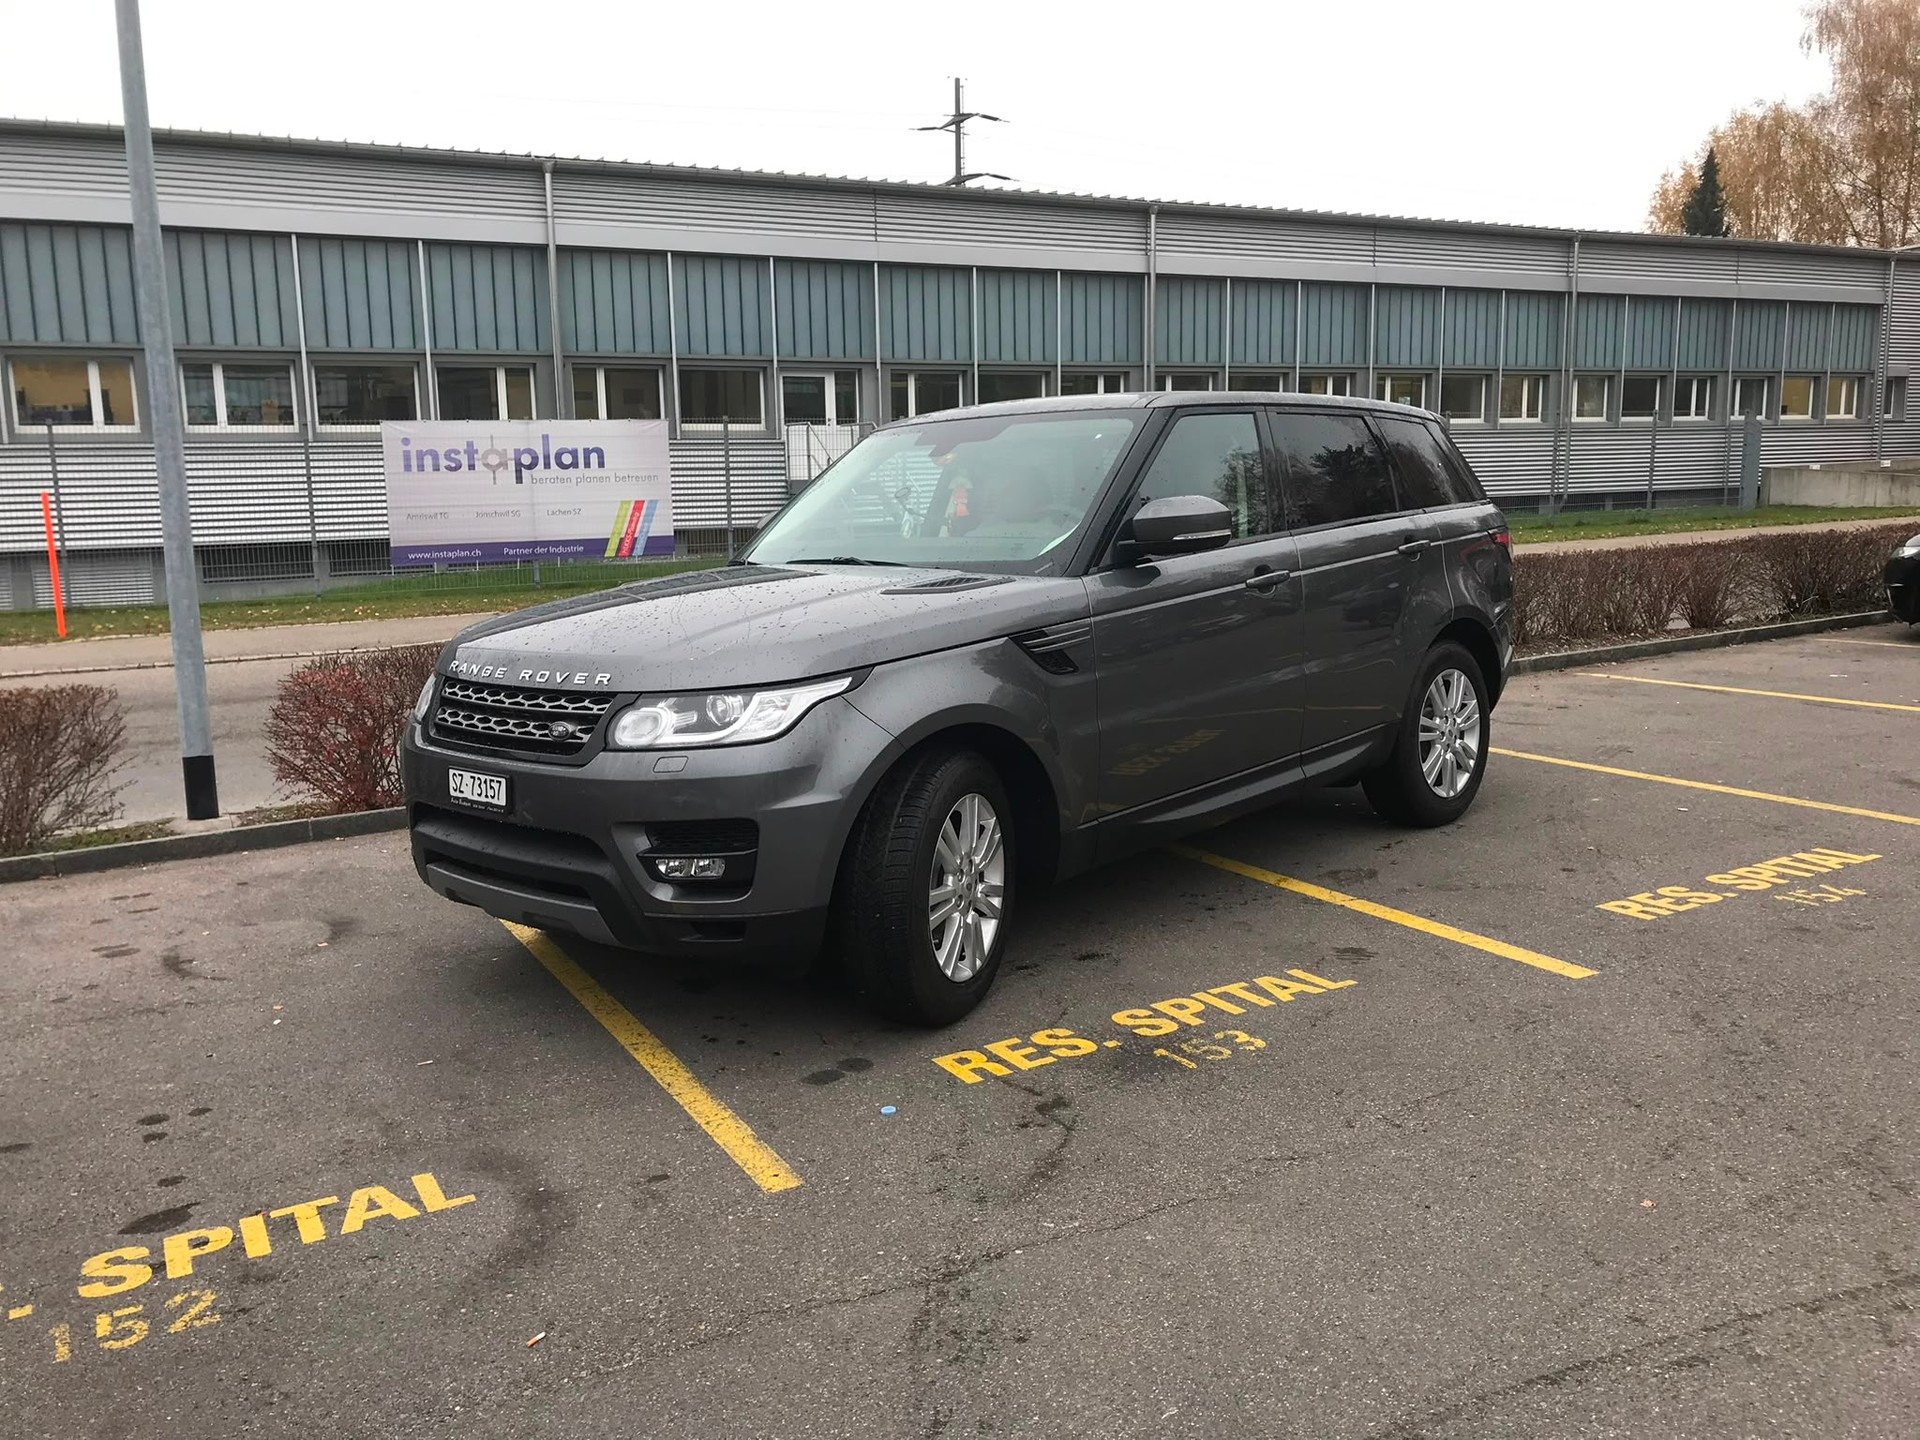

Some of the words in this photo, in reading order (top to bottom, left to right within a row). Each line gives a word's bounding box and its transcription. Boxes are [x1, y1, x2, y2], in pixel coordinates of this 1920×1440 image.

[401, 434, 606, 485] instaplan
[531, 472, 572, 486] beraten
[576, 472, 611, 486] planen
[614, 470, 659, 483] betreuen
[510, 510, 521, 518] SG
[547, 508, 571, 517] Lachen
[408, 548, 482, 560] www.instaplan.ch
[503, 546, 532, 556] Partner
[534, 546, 548, 555] der
[549, 544, 584, 554] Industrie
[449, 660, 507, 678] RANGE
[519, 669, 611, 685] ROVER
[1596, 886, 1738, 920] RES.
[1705, 848, 1883, 891] SPITAL
[931, 1028, 1122, 1084] RES.
[1111, 968, 1358, 1037] SPITAL
[1153, 1029, 1267, 1069] 153
[77, 1172, 477, 1298] SPITAL
[48, 1289, 222, 1364] 152
